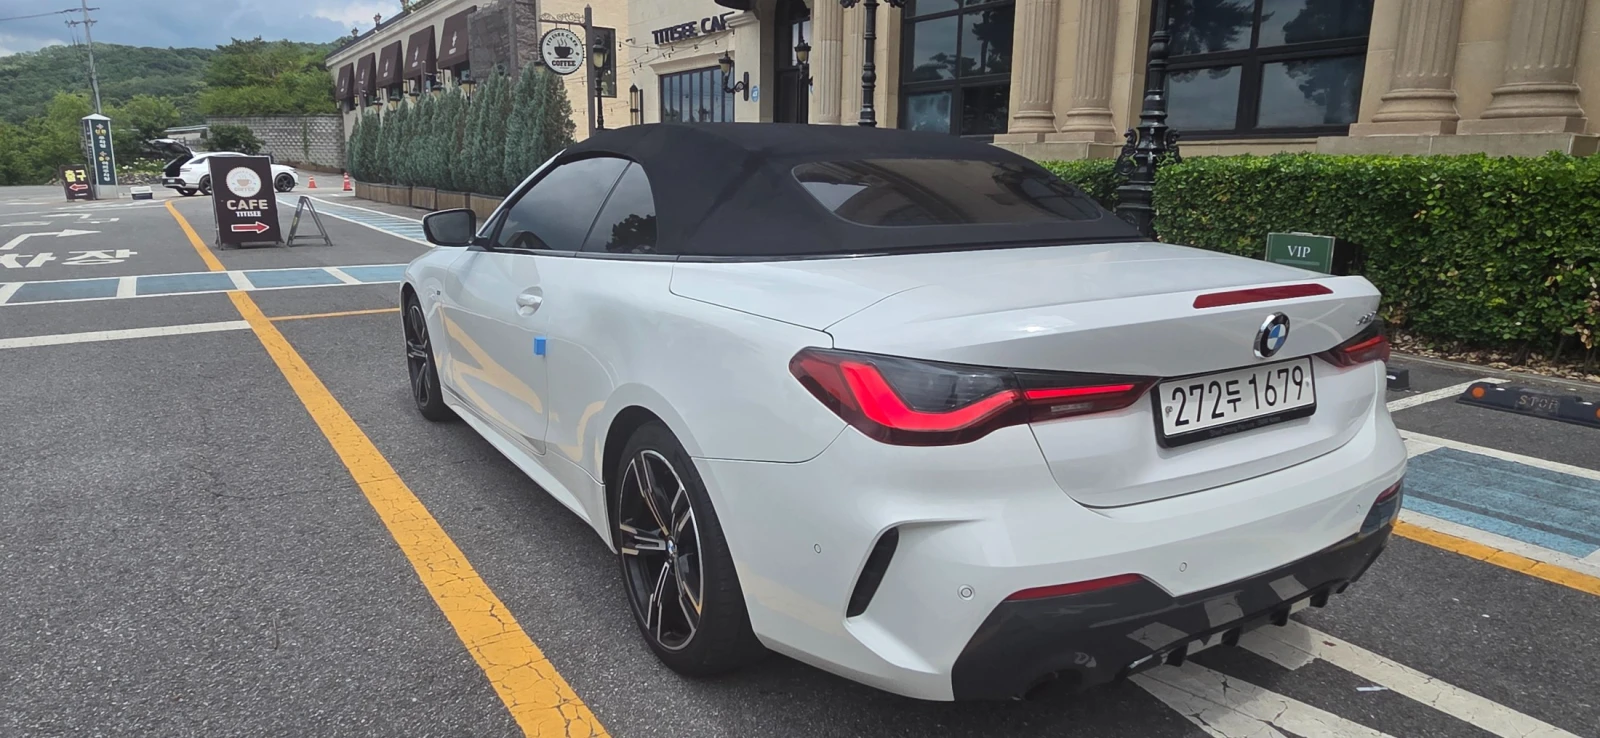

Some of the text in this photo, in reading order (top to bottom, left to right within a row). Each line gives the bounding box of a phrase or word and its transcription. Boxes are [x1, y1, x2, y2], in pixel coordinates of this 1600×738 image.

[652, 11, 735, 45] TITISEE CAF
[226, 199, 269, 210] CAFE
[1287, 245, 1311, 258] VIP
[1248, 365, 1304, 410] 1679
[1518, 395, 1558, 411] STOP
